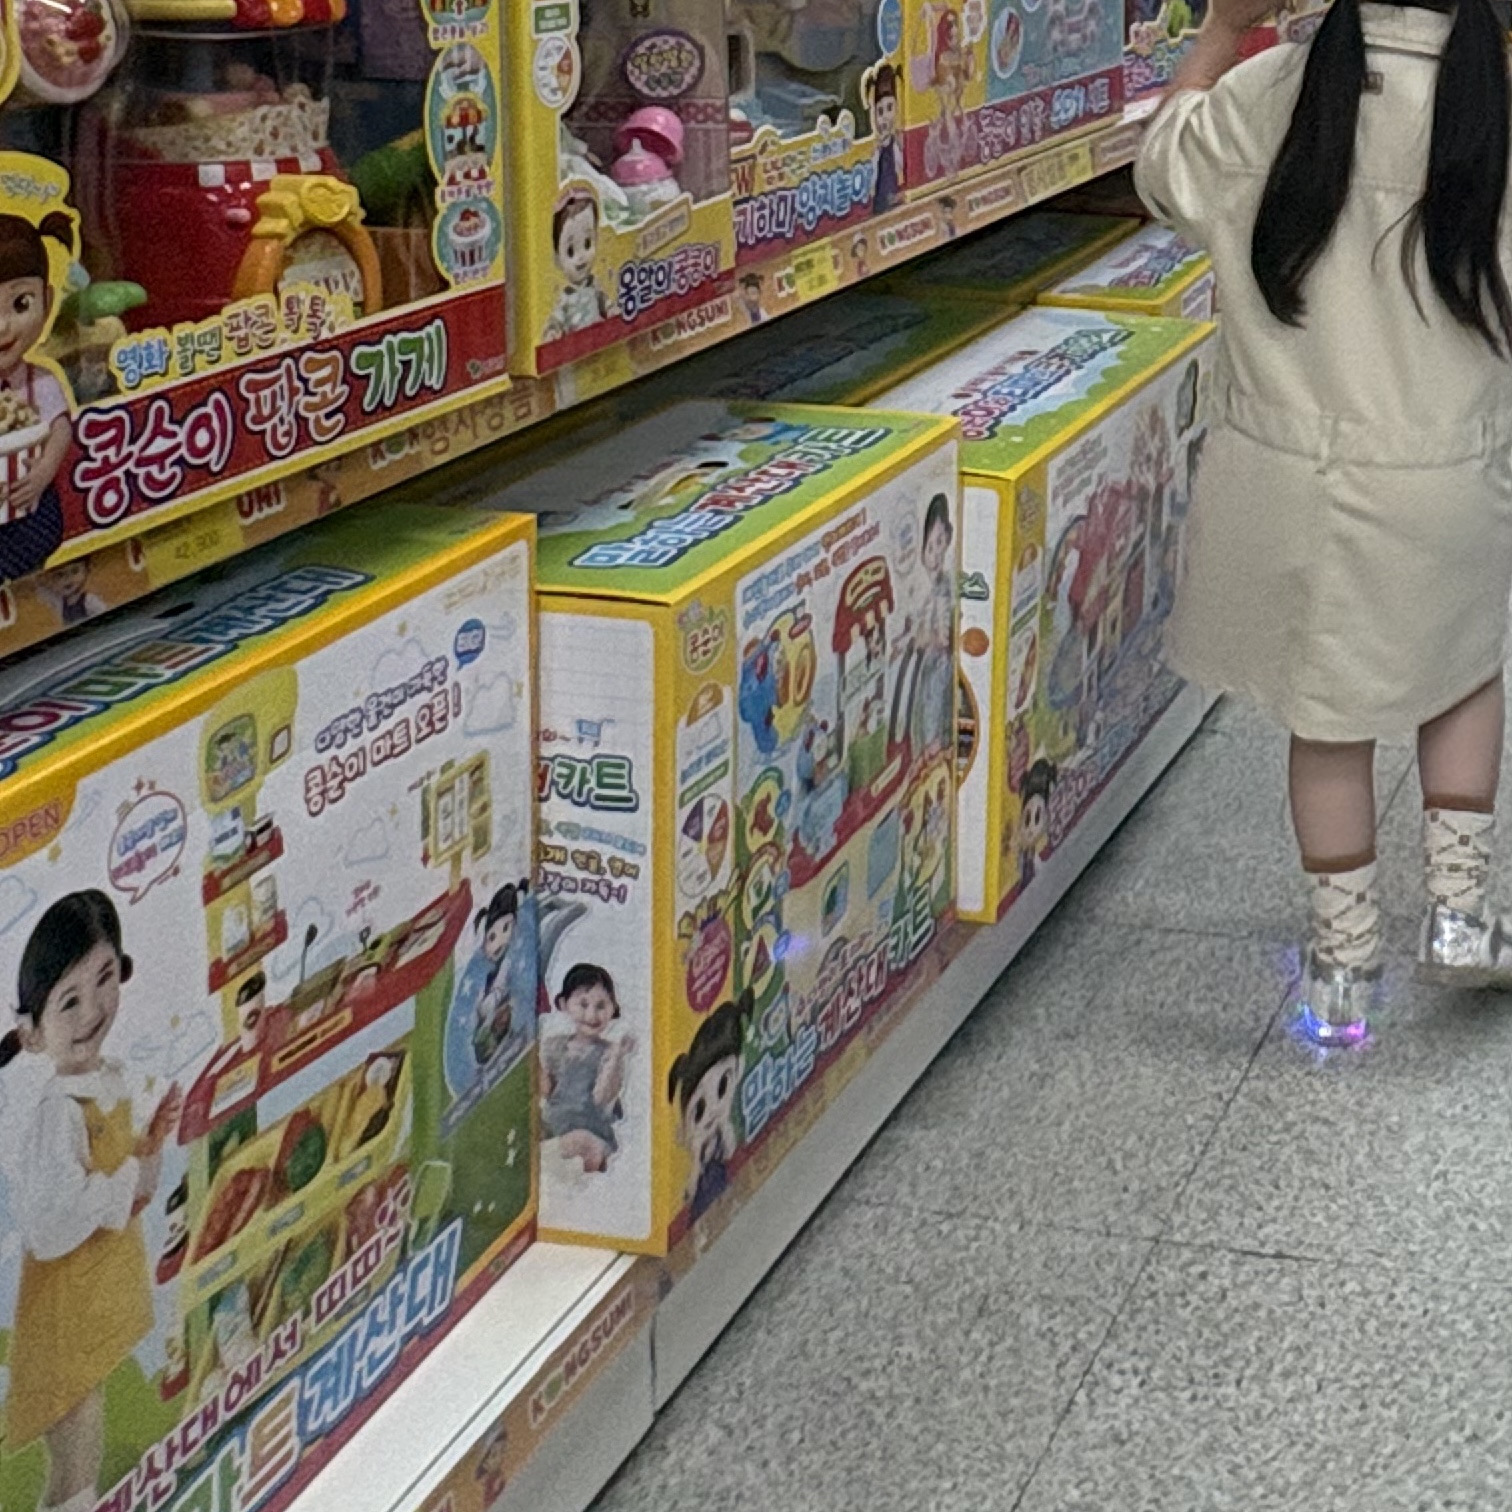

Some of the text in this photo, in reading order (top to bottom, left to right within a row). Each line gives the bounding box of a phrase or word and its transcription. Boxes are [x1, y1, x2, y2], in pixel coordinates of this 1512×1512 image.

[734, 193, 798, 244] 기하마
[115, 336, 168, 389] 영화
[224, 302, 277, 354] 팝콘
[74, 319, 447, 524] 콩순이 팝콘 가게
[303, 745, 367, 817] 콩순이
[370, 716, 412, 767] 마트
[555, 759, 636, 809] 카트
[0, 799, 63, 861] OPEN
[303, 1218, 462, 1432] 계산대
[530, 1288, 634, 1426] KONGSUNI
